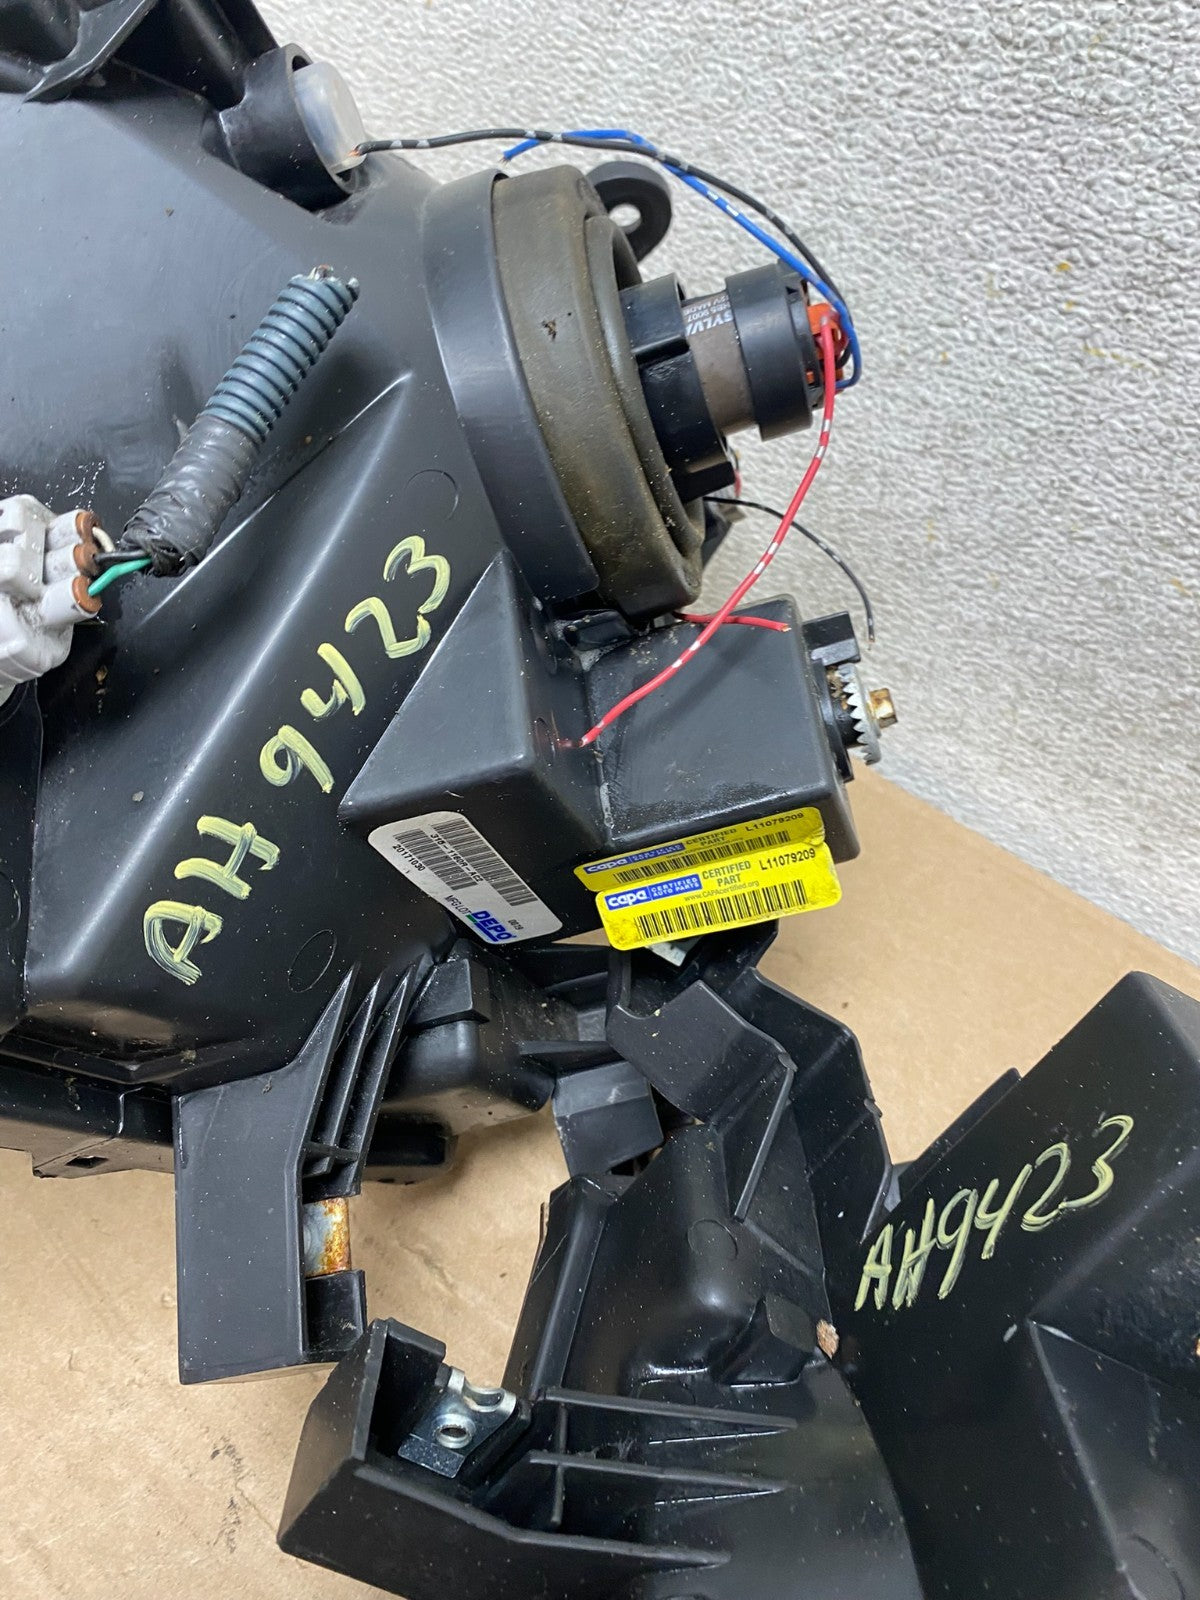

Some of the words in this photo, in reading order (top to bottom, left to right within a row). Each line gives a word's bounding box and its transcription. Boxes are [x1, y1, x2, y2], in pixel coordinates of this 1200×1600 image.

[685, 828, 737, 845] CERTIFIED
[392, 844, 426, 872] 20171030
[587, 858, 628, 872] capa
[759, 848, 816, 870] L11079209
[702, 860, 751, 879] CERTIFIED
[651, 877, 698, 893] CERTIFIED
[717, 873, 742, 887] PART
[608, 889, 648, 906] capa
[653, 888, 673, 897] AUTO
[676, 882, 700, 892] PARTS
[684, 880, 760, 901] www.CAPAcertified.org
[472, 911, 512, 940] DEPO
[854, 1115, 1134, 1311] AH9423
